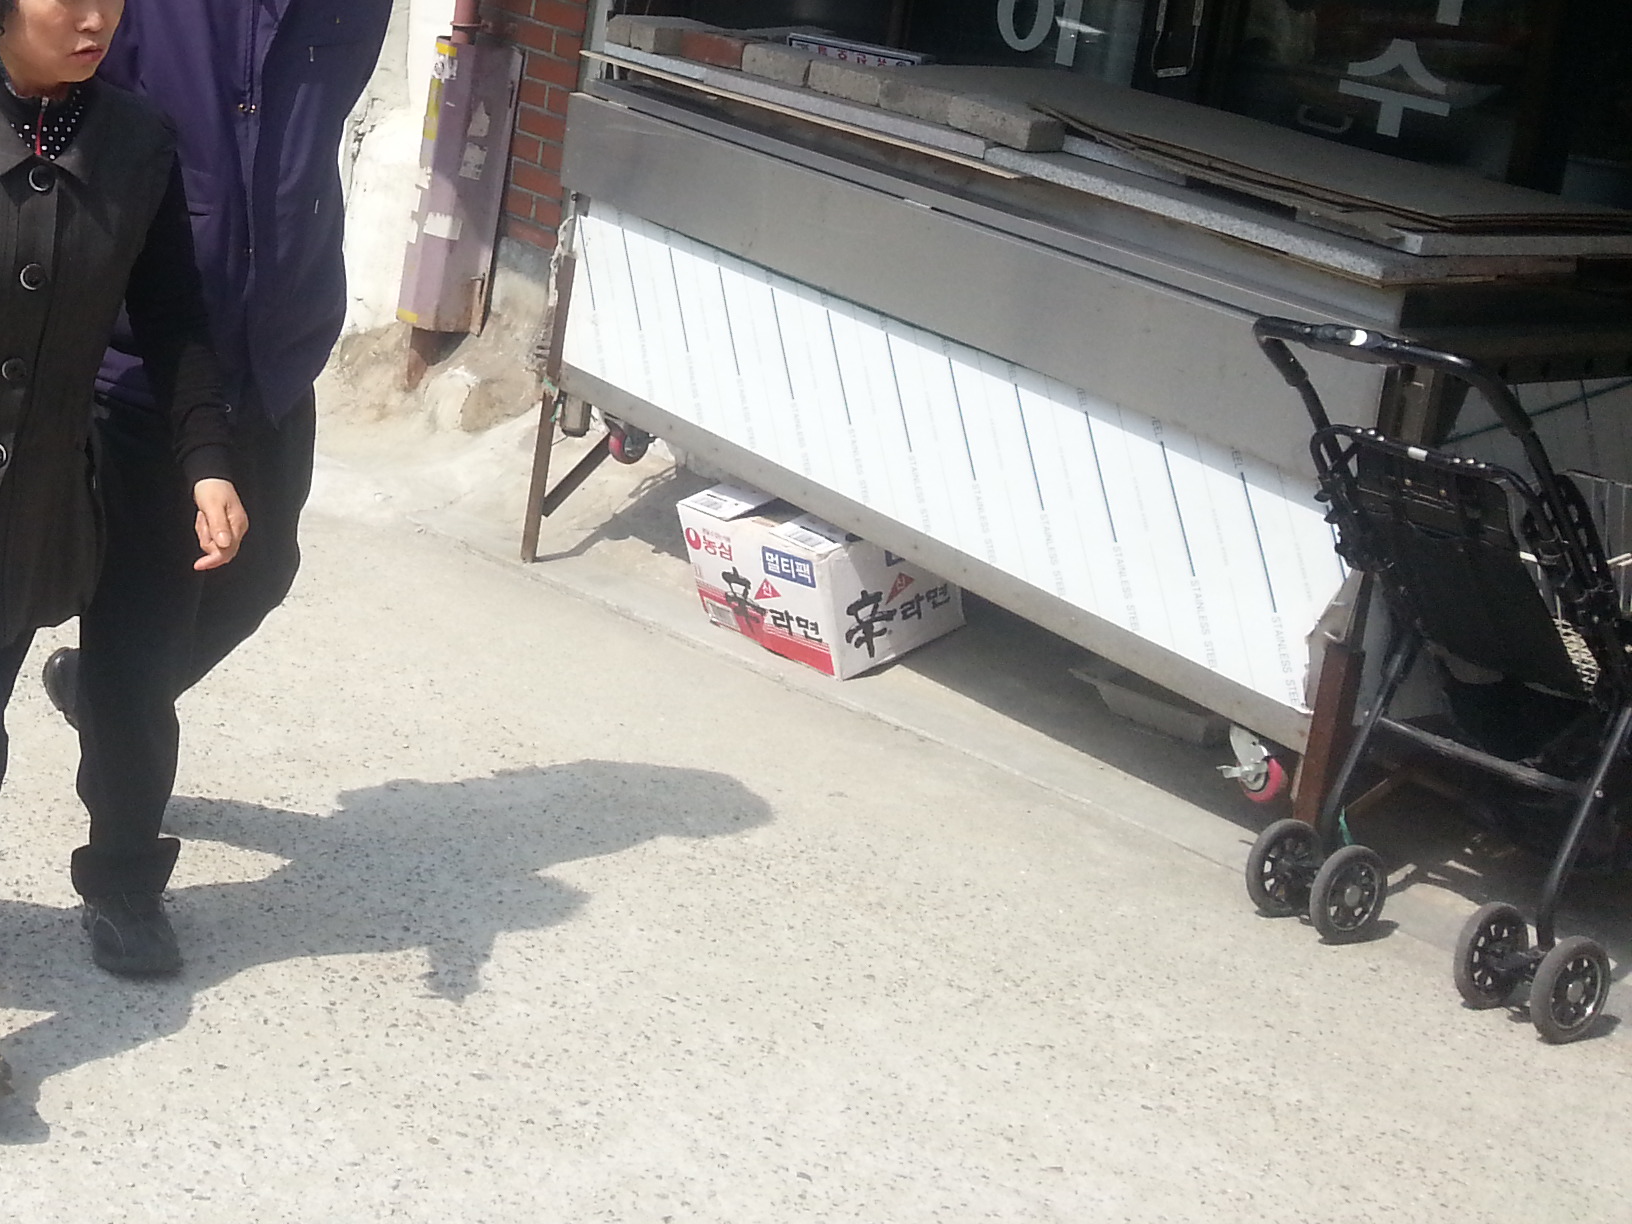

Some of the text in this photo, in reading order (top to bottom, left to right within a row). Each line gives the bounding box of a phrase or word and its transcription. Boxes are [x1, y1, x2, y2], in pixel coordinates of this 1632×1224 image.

[702, 534, 734, 562] 농심
[1040, 513, 1060, 566] STAINLESS
[765, 551, 813, 584] 멀티팩
[1113, 546, 1134, 600] STAINLESS
[1191, 579, 1211, 636] STAINLESS
[1271, 616, 1293, 675] STAINLESS
